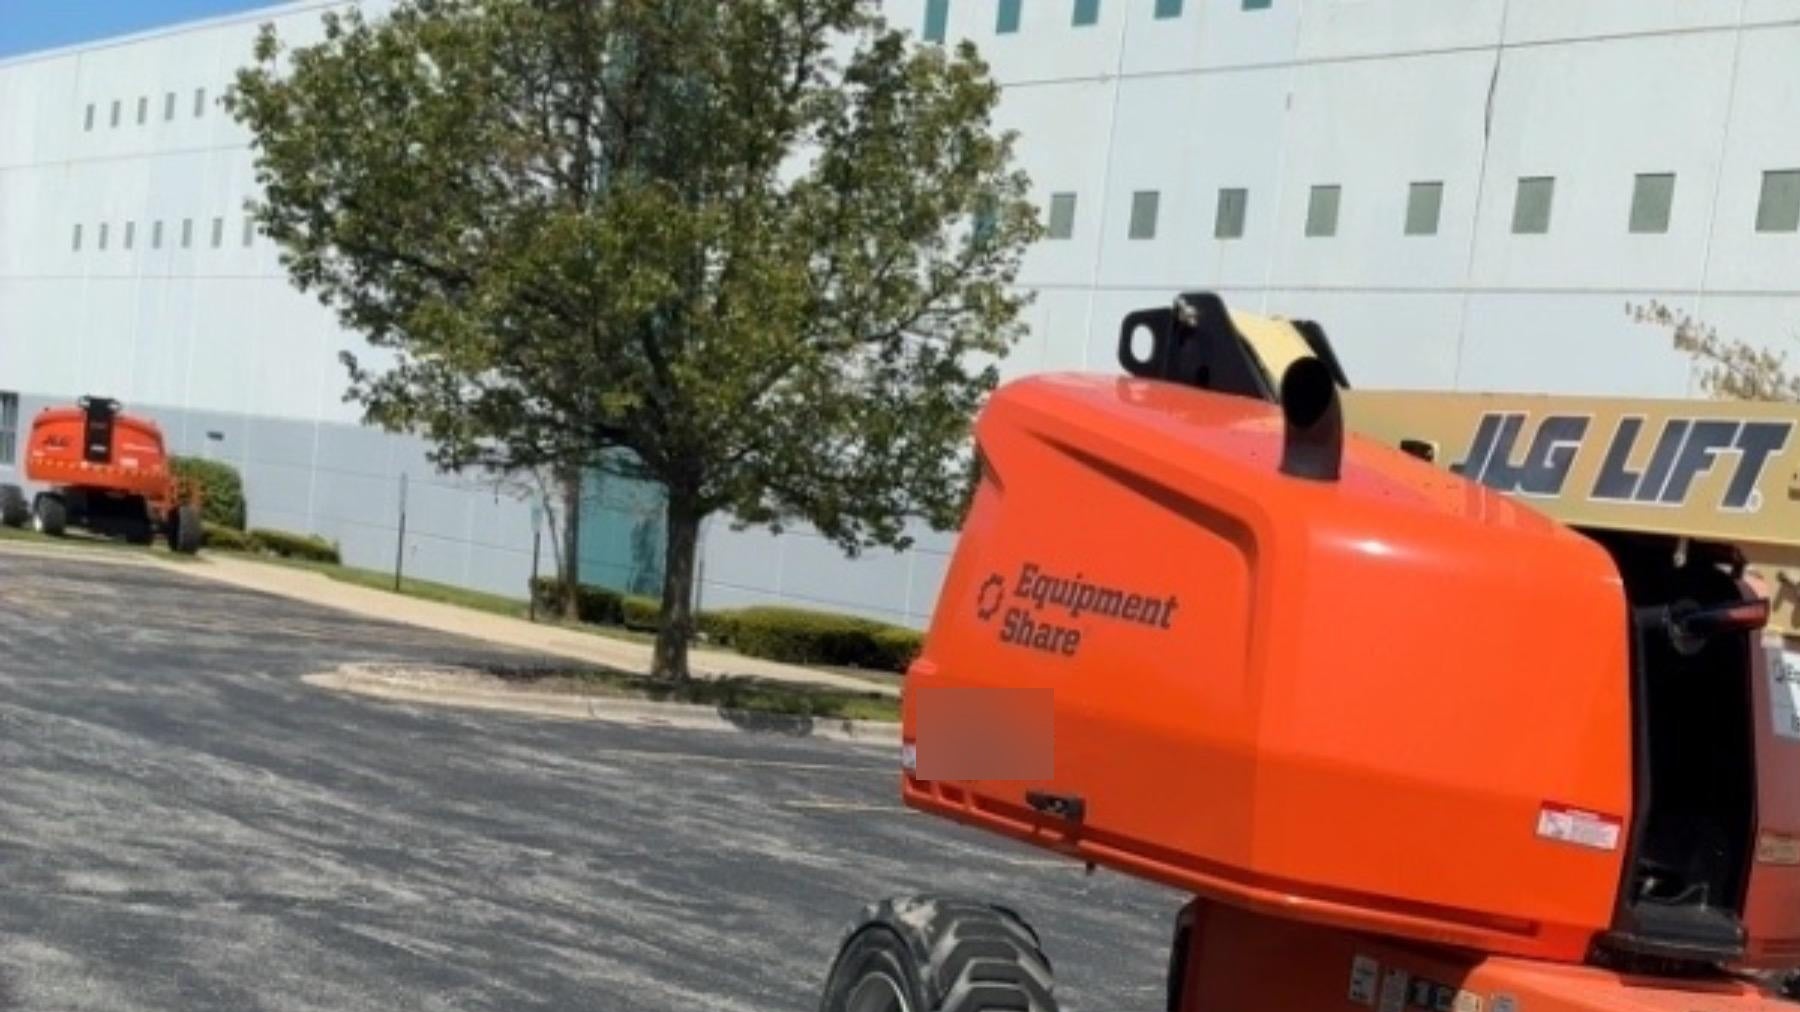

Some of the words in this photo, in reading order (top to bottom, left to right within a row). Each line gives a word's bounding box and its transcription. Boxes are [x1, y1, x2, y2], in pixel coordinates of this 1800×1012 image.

[1450, 411, 1596, 499] JLG
[1013, 562, 1180, 630] Equipment
[1000, 607, 1081, 656] Share
